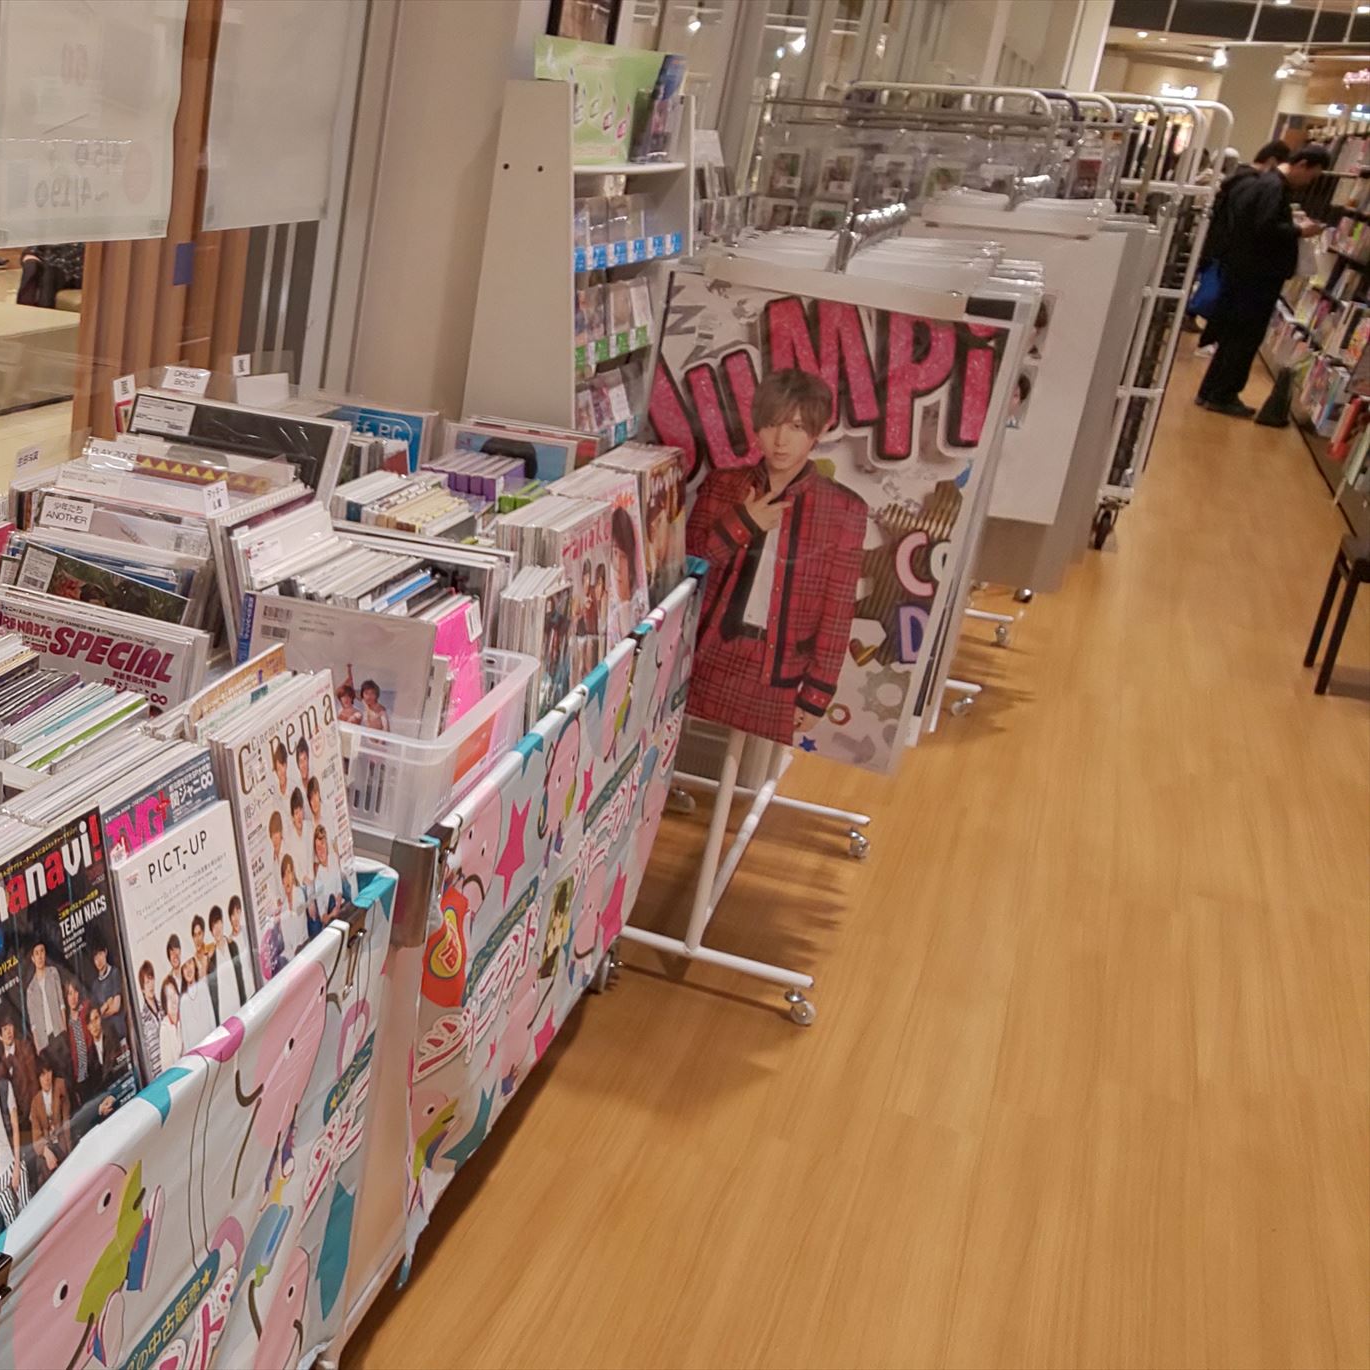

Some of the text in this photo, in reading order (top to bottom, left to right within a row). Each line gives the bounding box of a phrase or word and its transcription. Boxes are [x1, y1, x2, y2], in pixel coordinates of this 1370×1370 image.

[49, 626, 176, 684] SPECIAL
[59, 894, 107, 939] TEAM NACS
